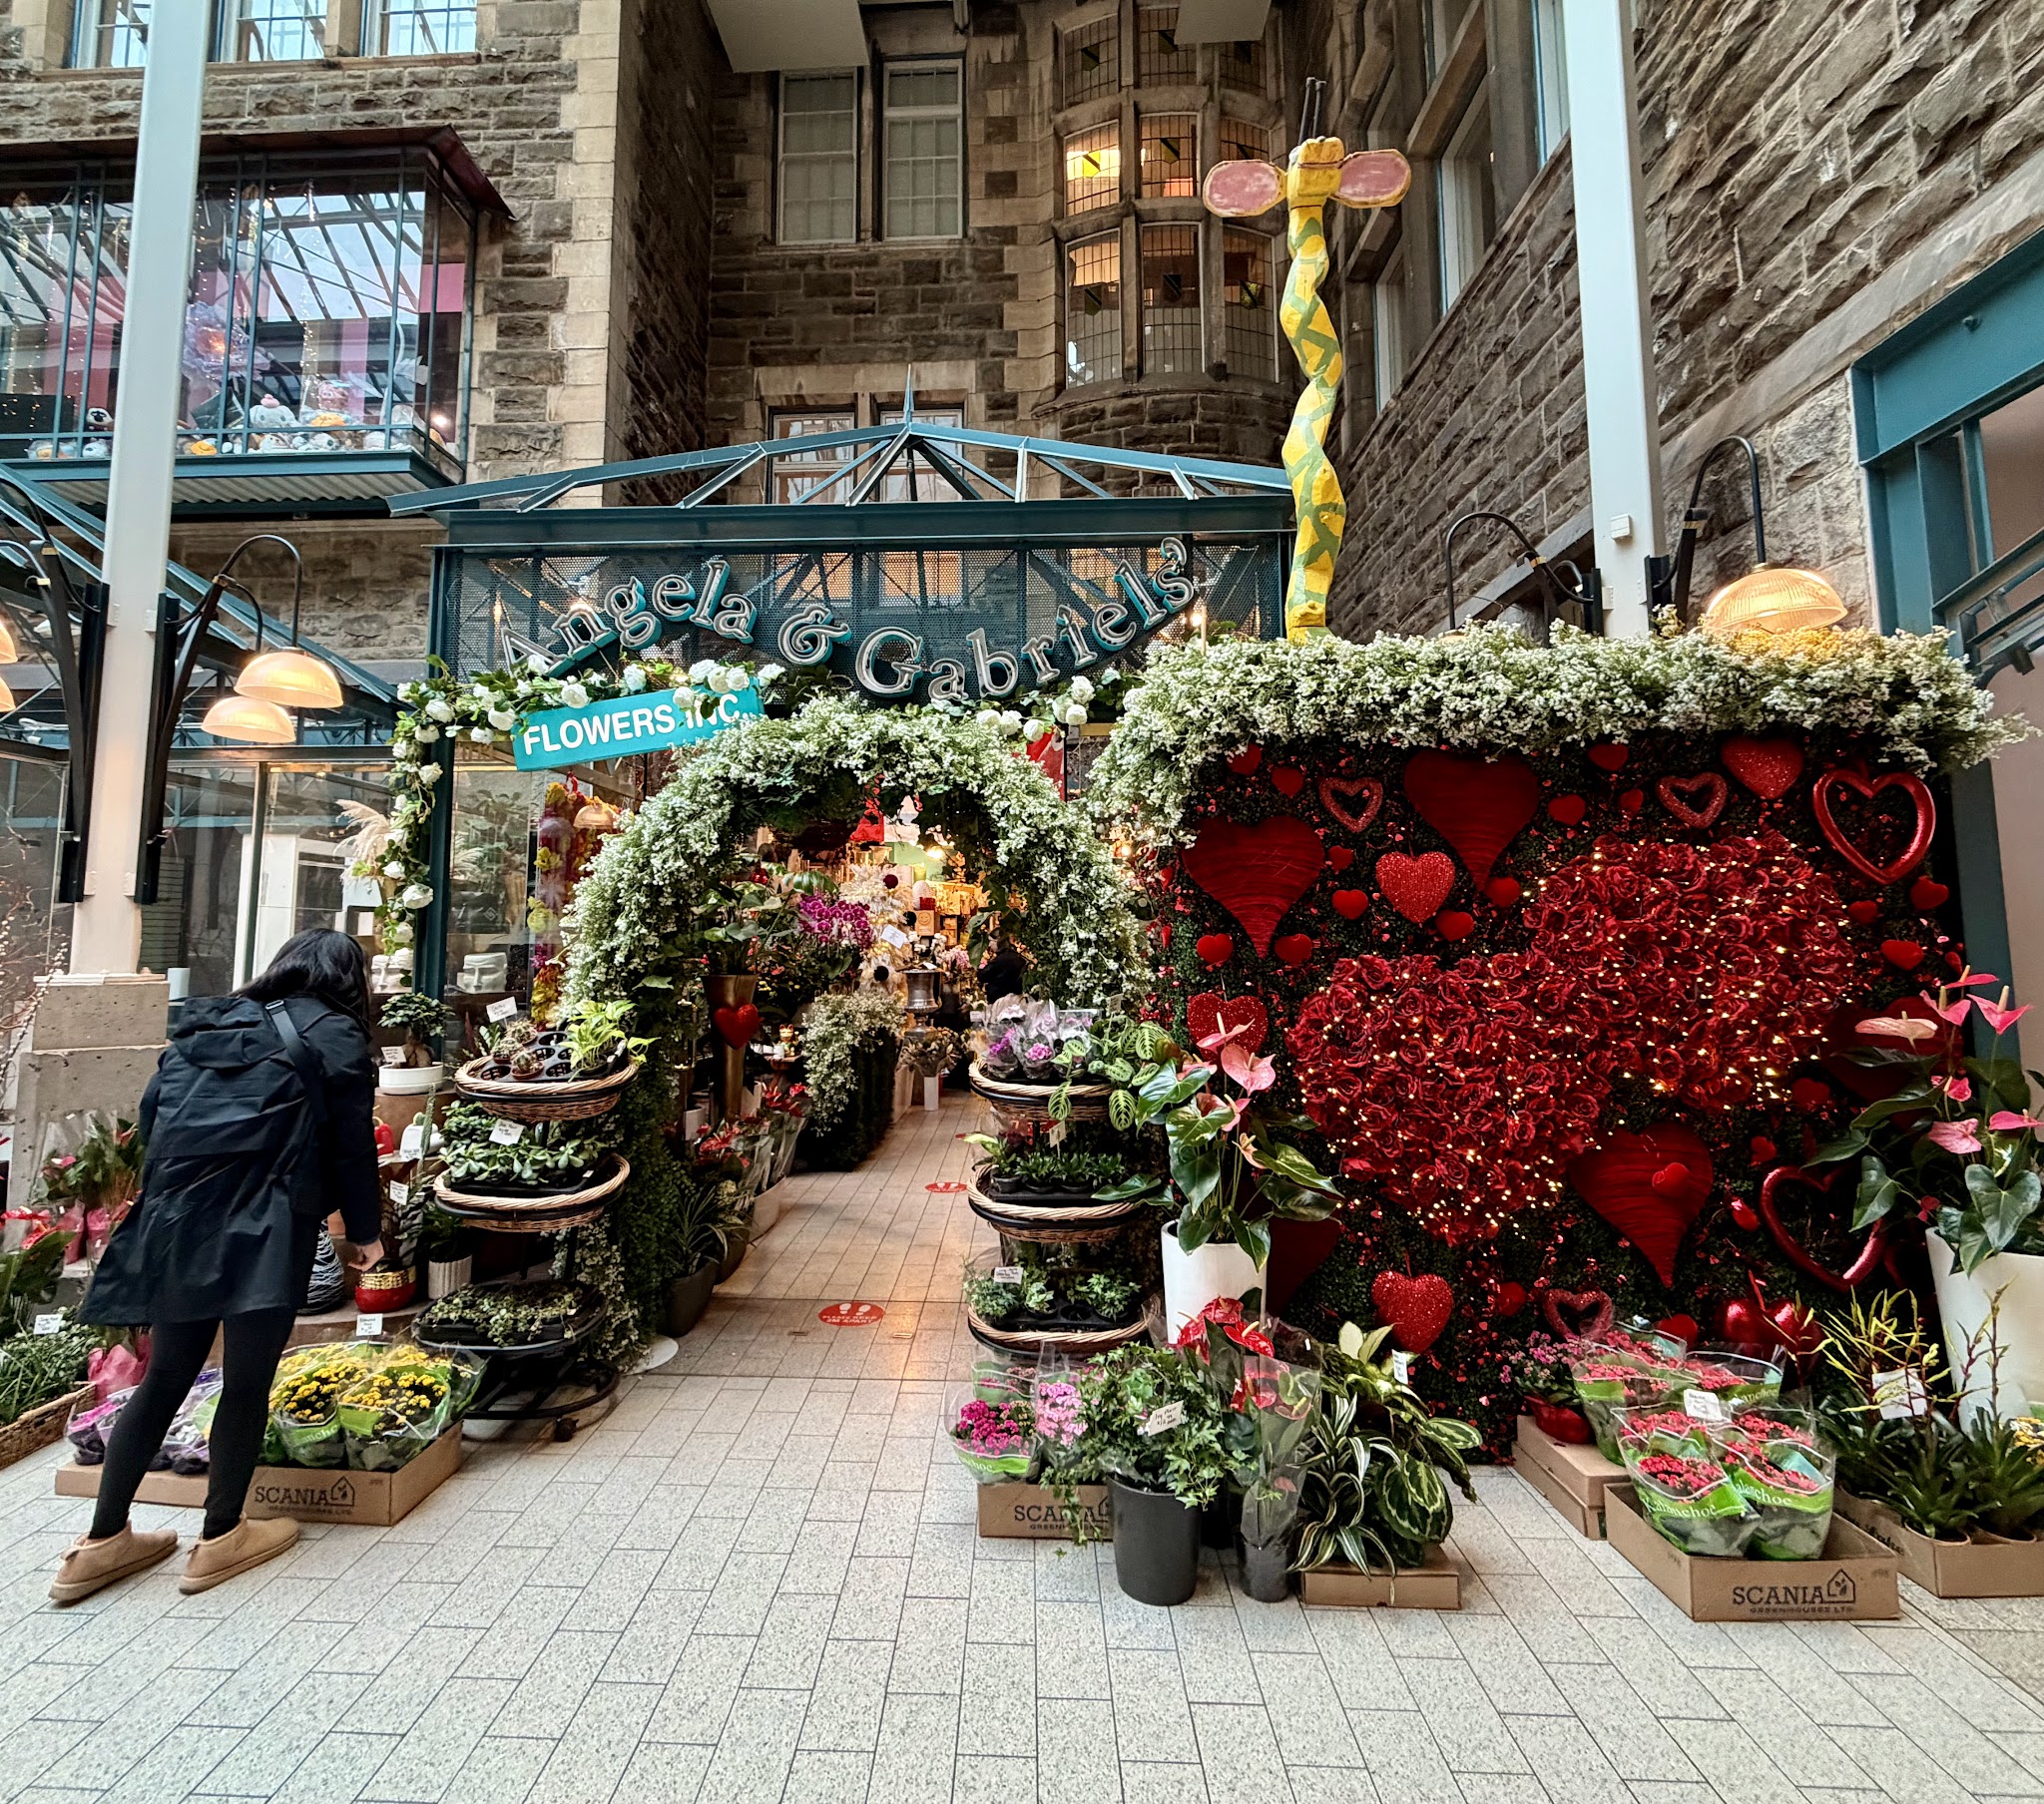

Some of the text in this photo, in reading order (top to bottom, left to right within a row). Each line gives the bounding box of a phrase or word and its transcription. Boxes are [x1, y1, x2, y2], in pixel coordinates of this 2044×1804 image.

[501, 560, 759, 678] Angela
[777, 604, 852, 666] &
[523, 703, 677, 756] FLOWERS
[255, 1486, 330, 1506] SCANIA
[1014, 1505, 1097, 1523] SCAA
[1733, 1585, 1824, 1605] SCANIA
